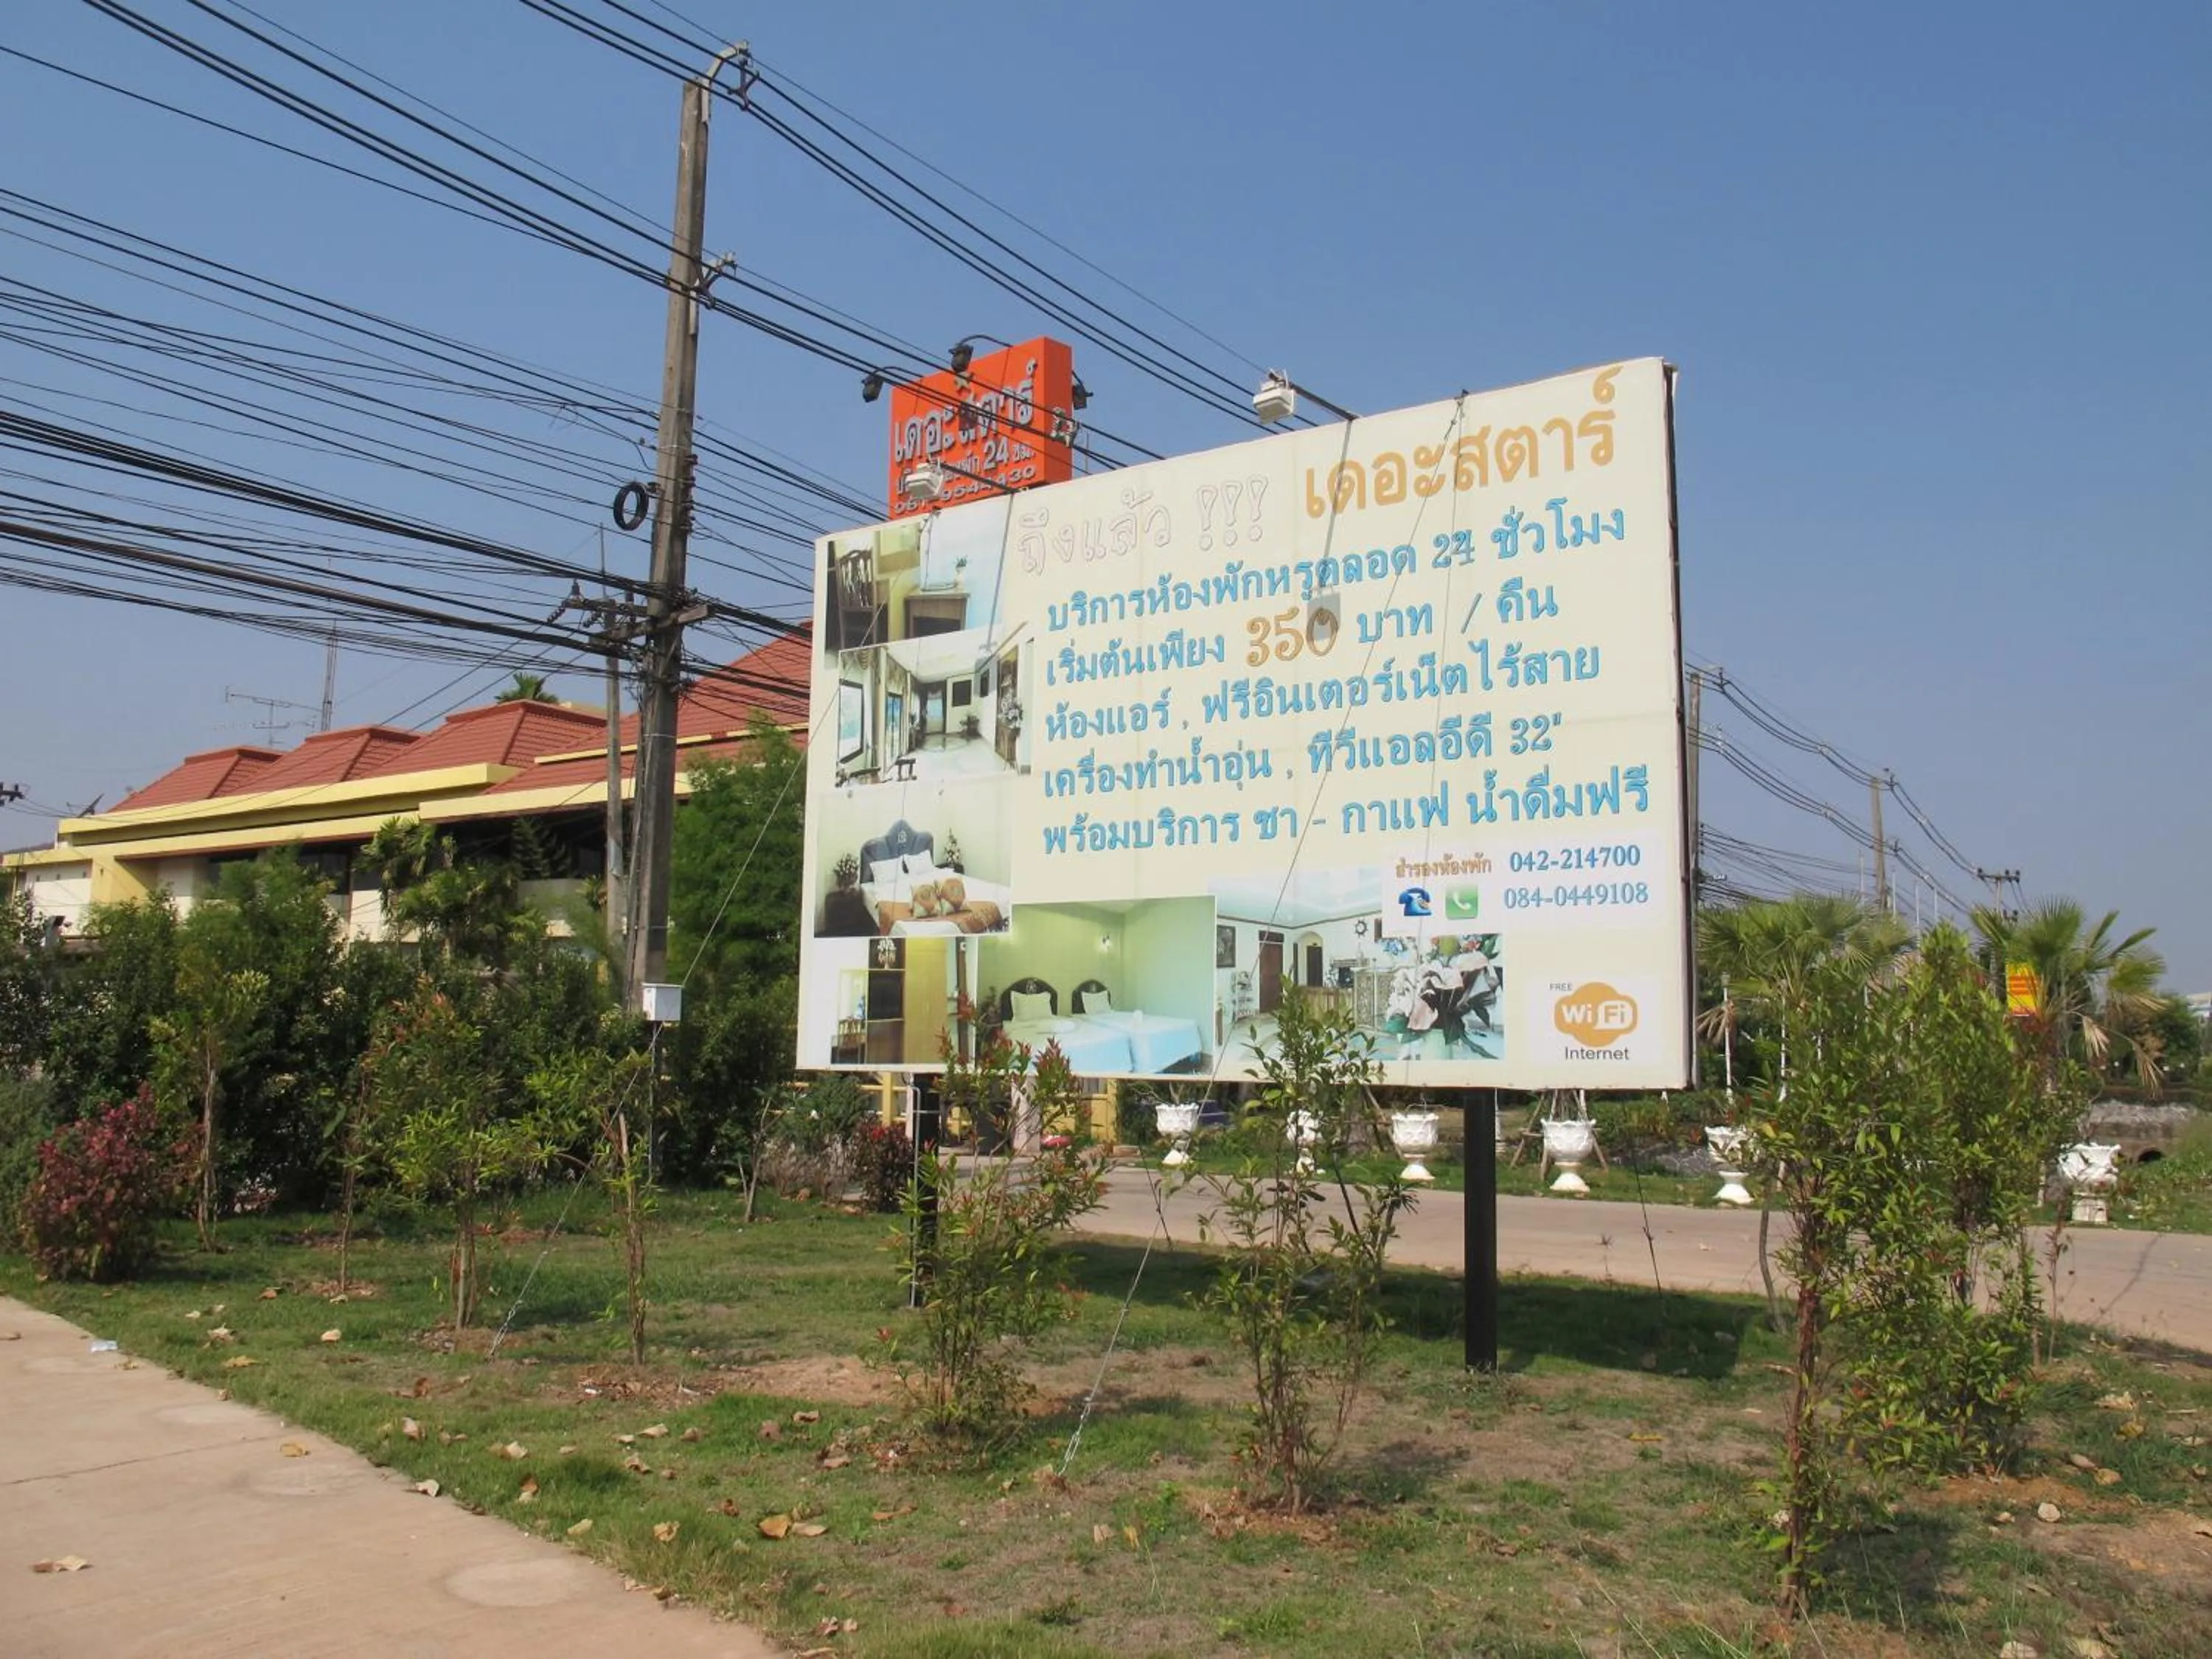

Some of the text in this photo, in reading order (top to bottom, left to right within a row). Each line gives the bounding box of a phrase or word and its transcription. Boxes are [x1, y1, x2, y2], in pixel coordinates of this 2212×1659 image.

[983, 436, 1010, 470] 24
[1305, 364, 1624, 519] เดอะสตาร์
[1017, 474, 1269, 577] ถึงแล้ว !!!
[1431, 529, 1475, 569] 24
[1490, 496, 1626, 560] ชั่วโมง
[1046, 576, 1559, 686] เริ่มต้นเพียง 350 บาท / คืน
[1045, 686, 1173, 742] ห้องแอร์
[1044, 736, 1274, 798] เครื่องทำน้ำอุ่น
[1307, 710, 1494, 774] ทีวีแอลอีดี
[1340, 779, 1450, 834] กาแฟ
[1465, 764, 1649, 825] น้ำดื่มฟรี
[1509, 844, 1641, 872] 042-214700
[1503, 881, 1649, 909] 084-0449108
[1549, 982, 1573, 992] FREE
[1565, 1046, 1630, 1060] Internet
